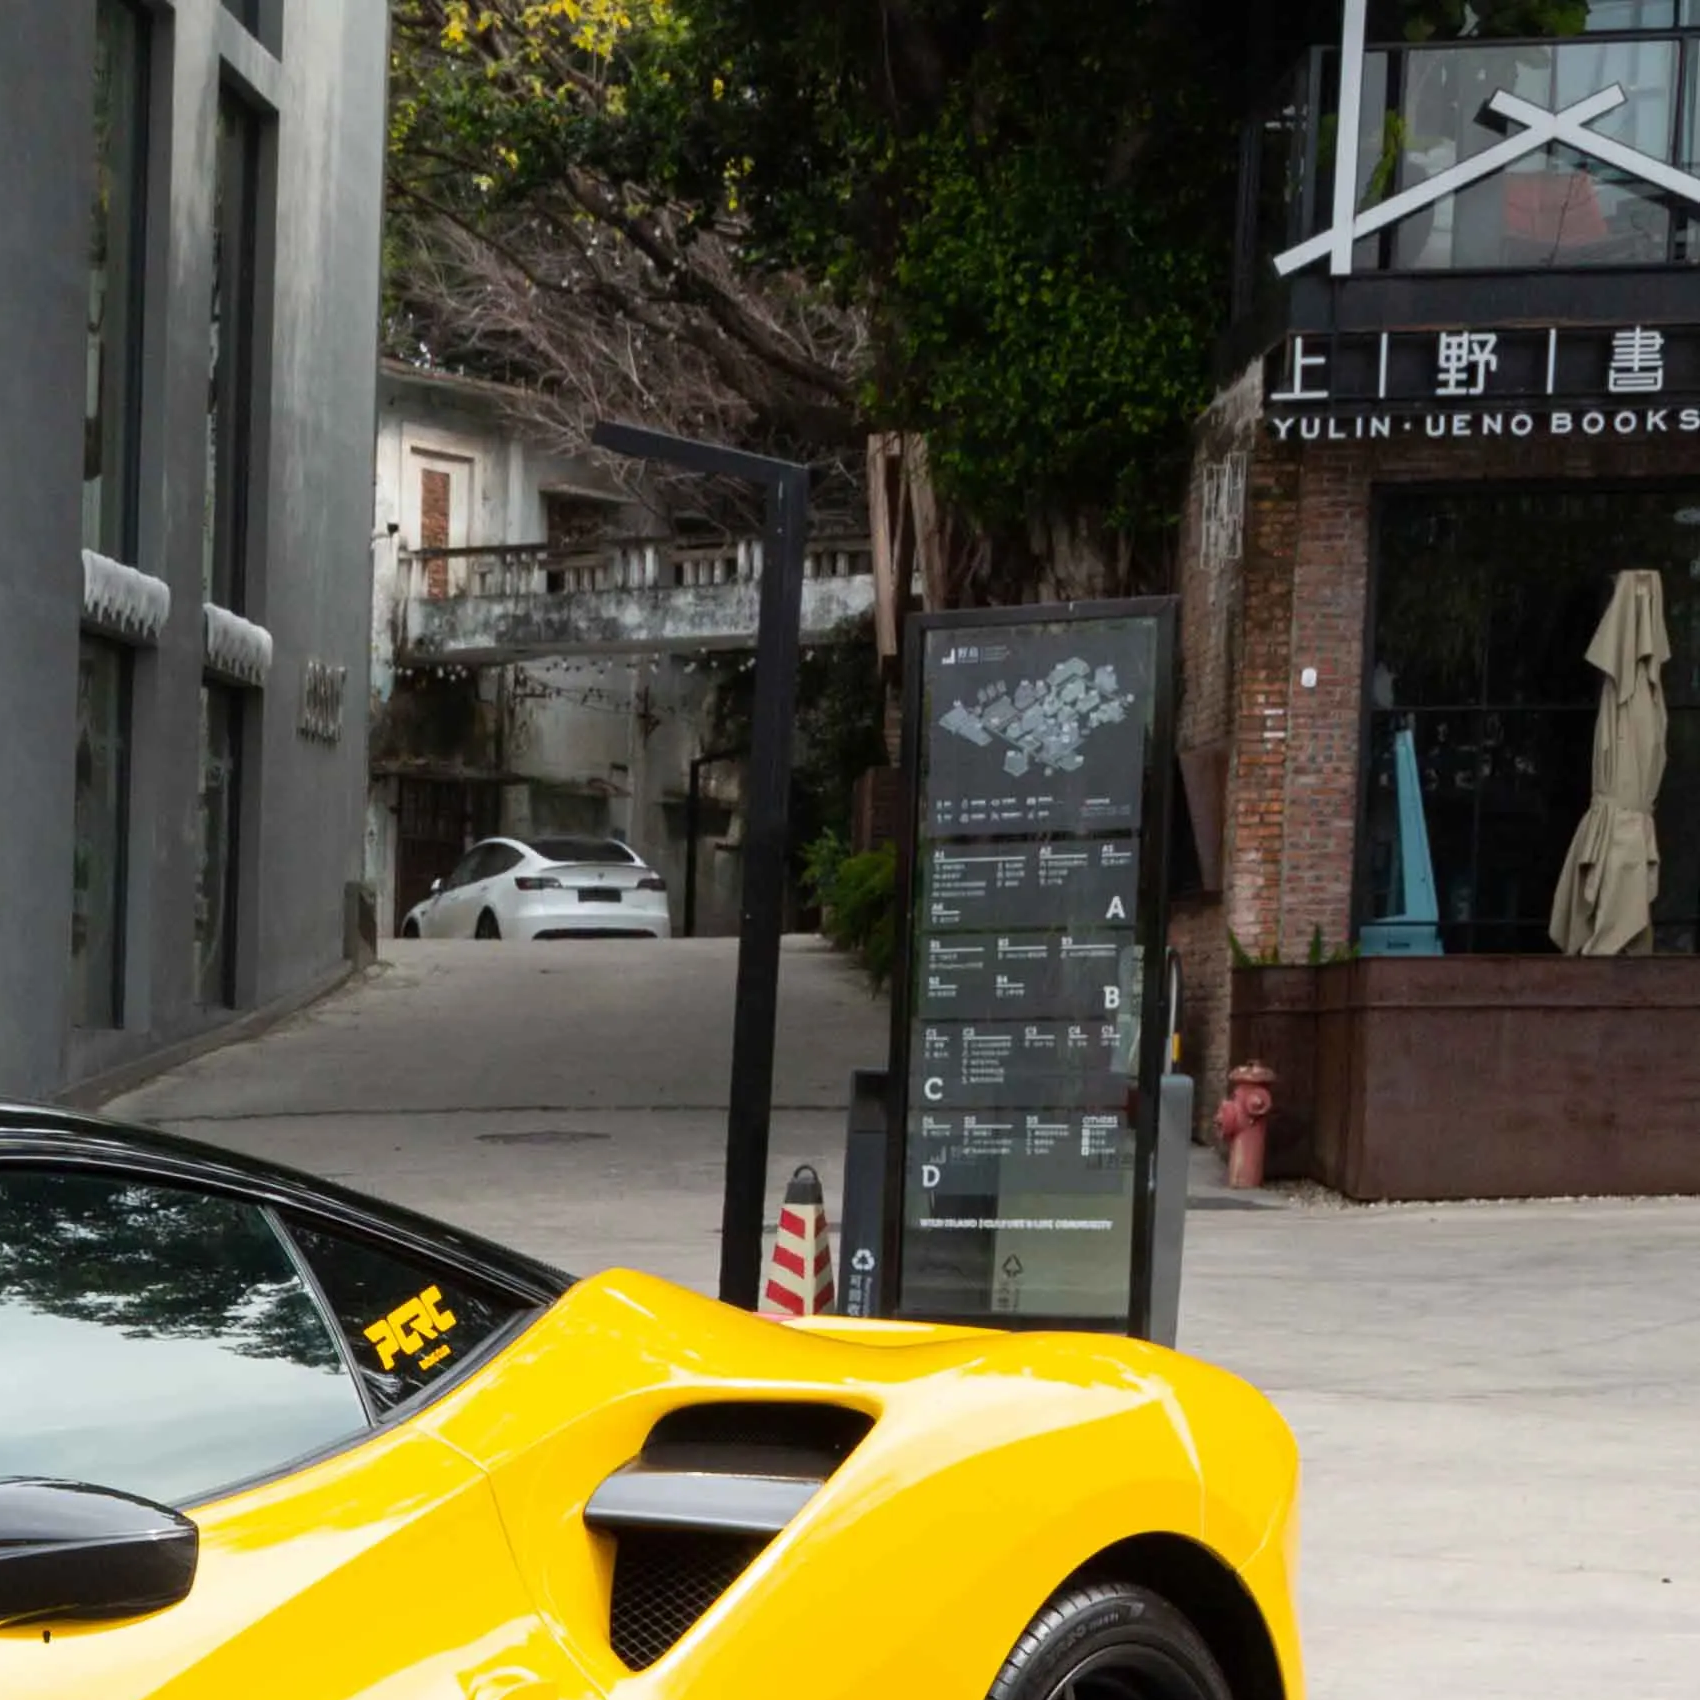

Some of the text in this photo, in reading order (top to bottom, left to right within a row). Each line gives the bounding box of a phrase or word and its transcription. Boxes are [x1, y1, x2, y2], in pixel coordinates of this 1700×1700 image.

[1273, 408, 1700, 440] YULIN UENO BOOKS
[1105, 896, 1126, 918] A
[1104, 986, 1120, 1009] B
[924, 1077, 944, 1100] C
[922, 1165, 940, 1187] D
